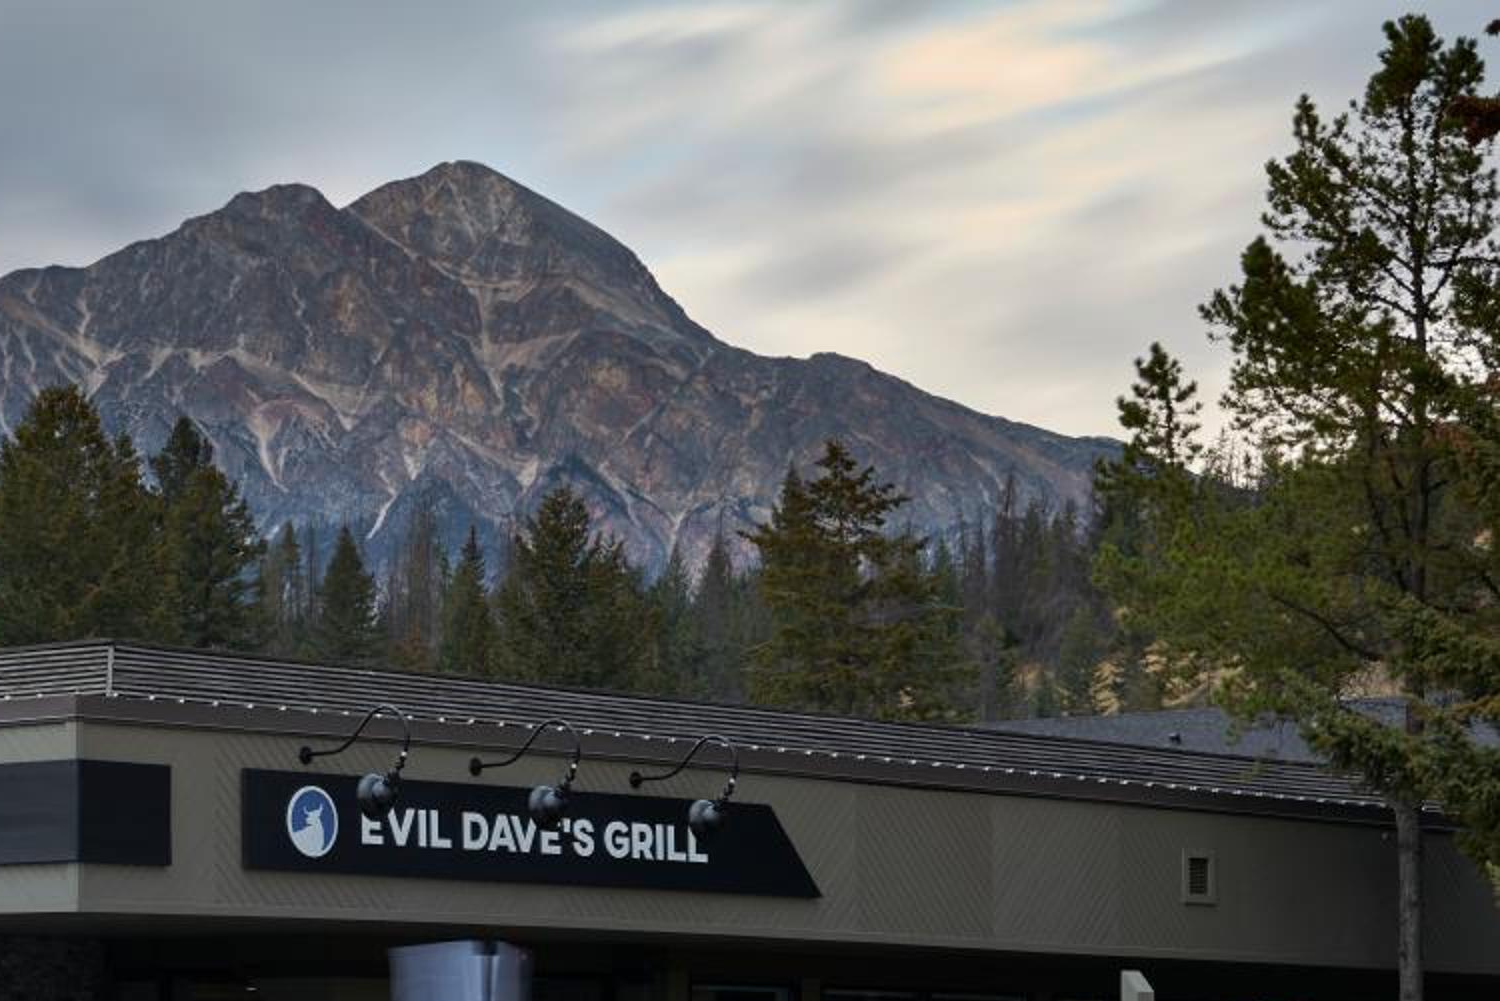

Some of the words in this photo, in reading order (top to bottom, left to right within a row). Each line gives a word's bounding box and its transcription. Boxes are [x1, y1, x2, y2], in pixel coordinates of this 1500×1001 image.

[360, 807, 452, 850] EVIL
[462, 811, 594, 858] DAVE'S
[603, 820, 709, 864] GRILL
